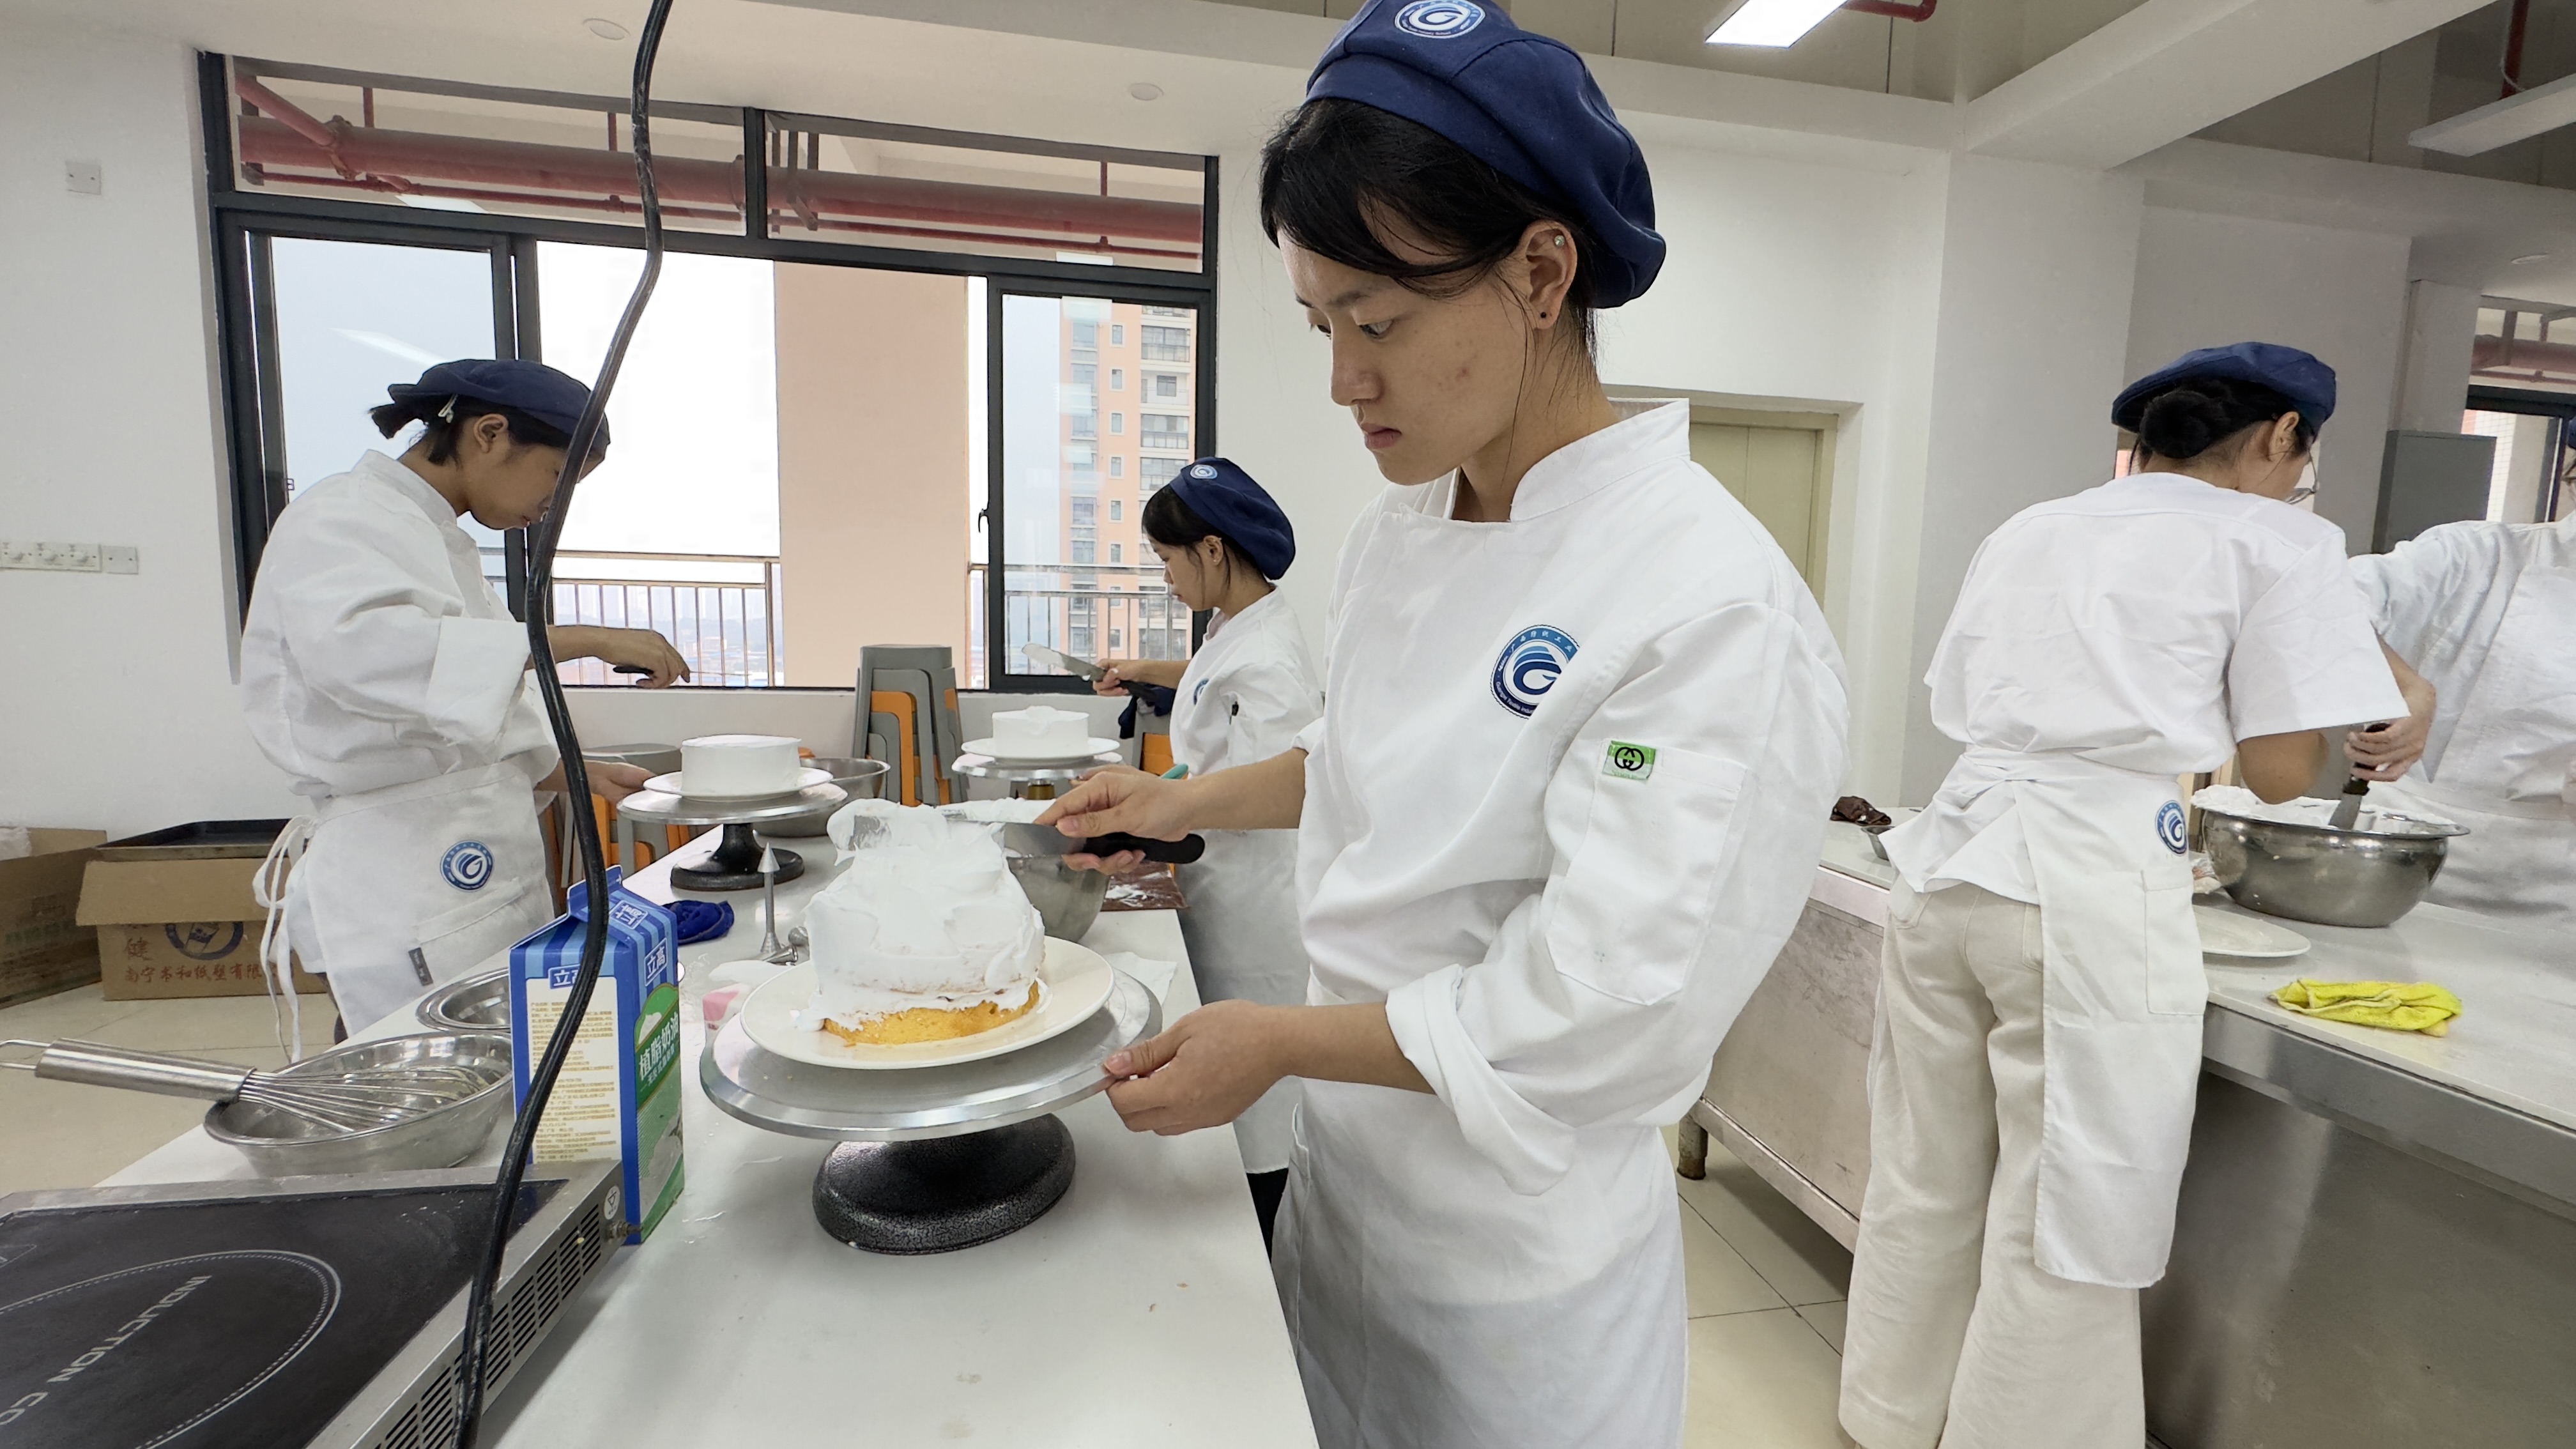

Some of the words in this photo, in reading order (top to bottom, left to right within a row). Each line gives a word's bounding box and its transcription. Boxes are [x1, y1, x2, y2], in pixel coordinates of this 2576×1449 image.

[614, 904, 643, 925] 立高
[647, 946, 666, 979] 立高
[639, 1011, 678, 1081] 植脂奶油
[47, 1275, 212, 1383] INDUCTION
[0, 1392, 49, 1425] CO
